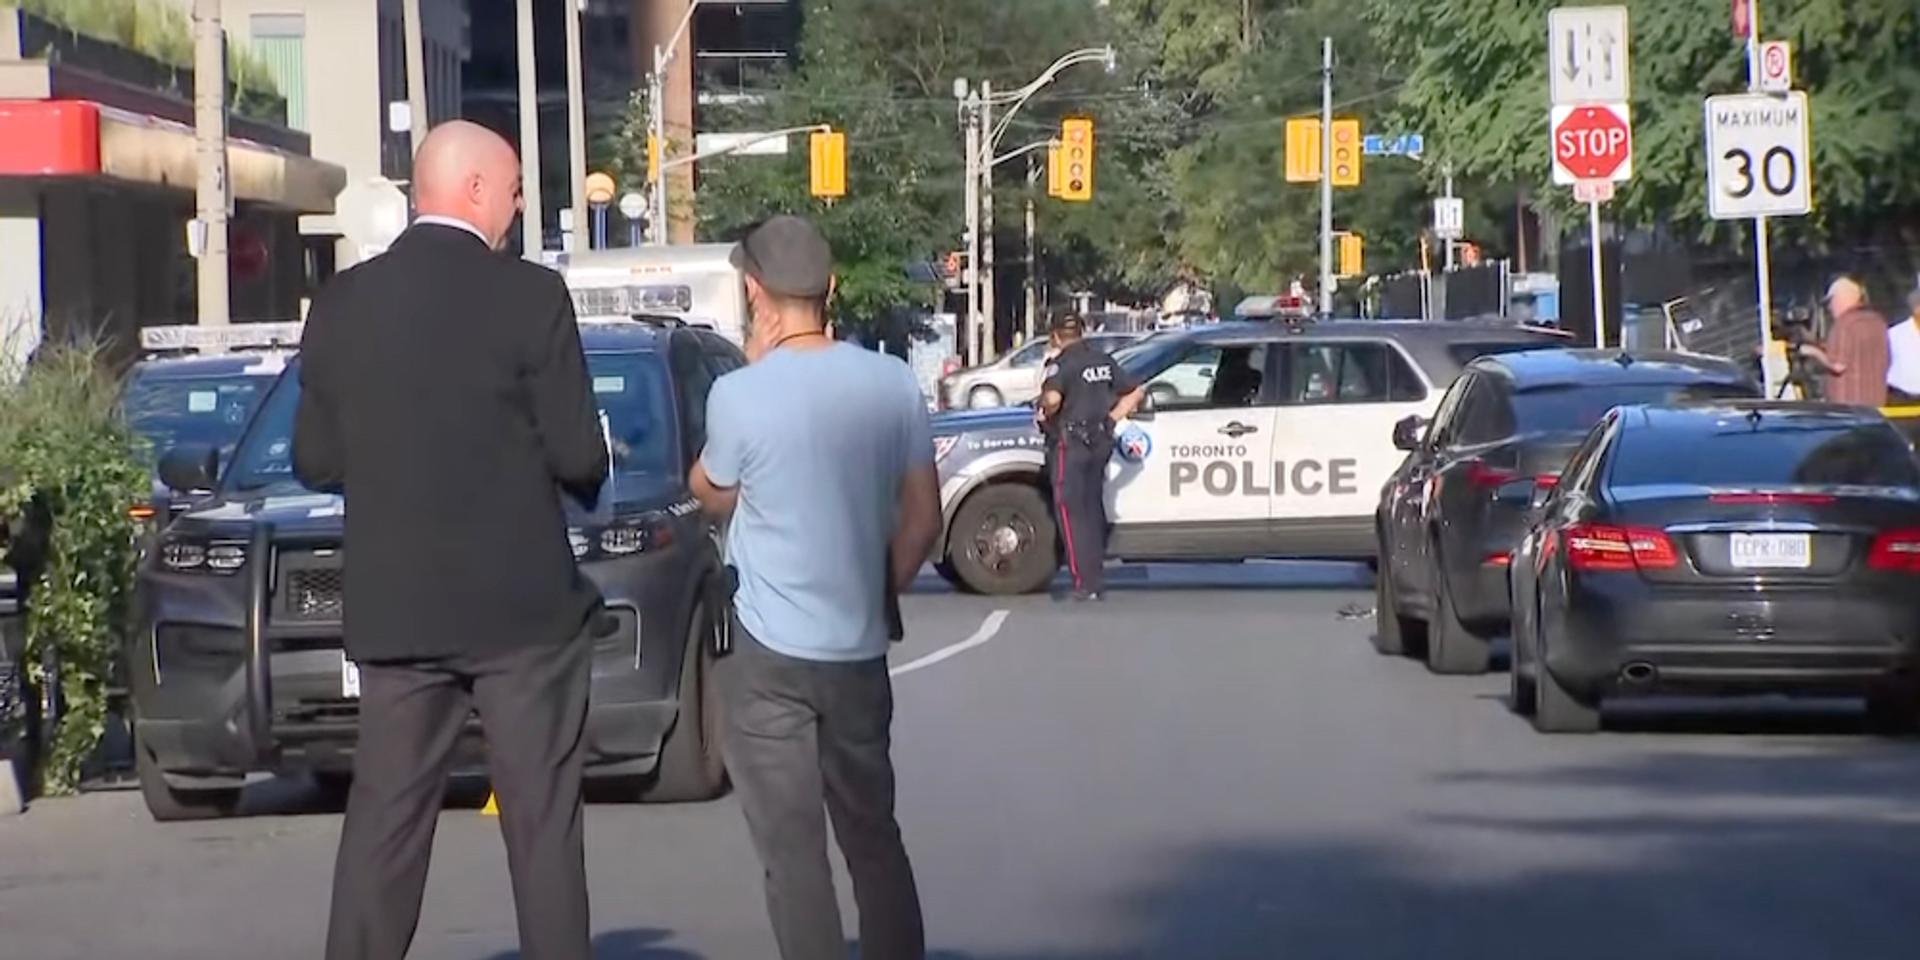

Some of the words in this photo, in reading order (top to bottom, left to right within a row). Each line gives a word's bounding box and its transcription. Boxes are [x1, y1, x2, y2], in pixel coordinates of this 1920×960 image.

[1717, 110, 1798, 129] MAXIMUM
[1560, 127, 1625, 160] STOP
[1723, 145, 1796, 198] 30
[1082, 365, 1112, 383] OLICE
[983, 438, 1015, 449] Serve
[1169, 444, 1248, 458] TORONTO
[1169, 459, 1358, 497] POLICE
